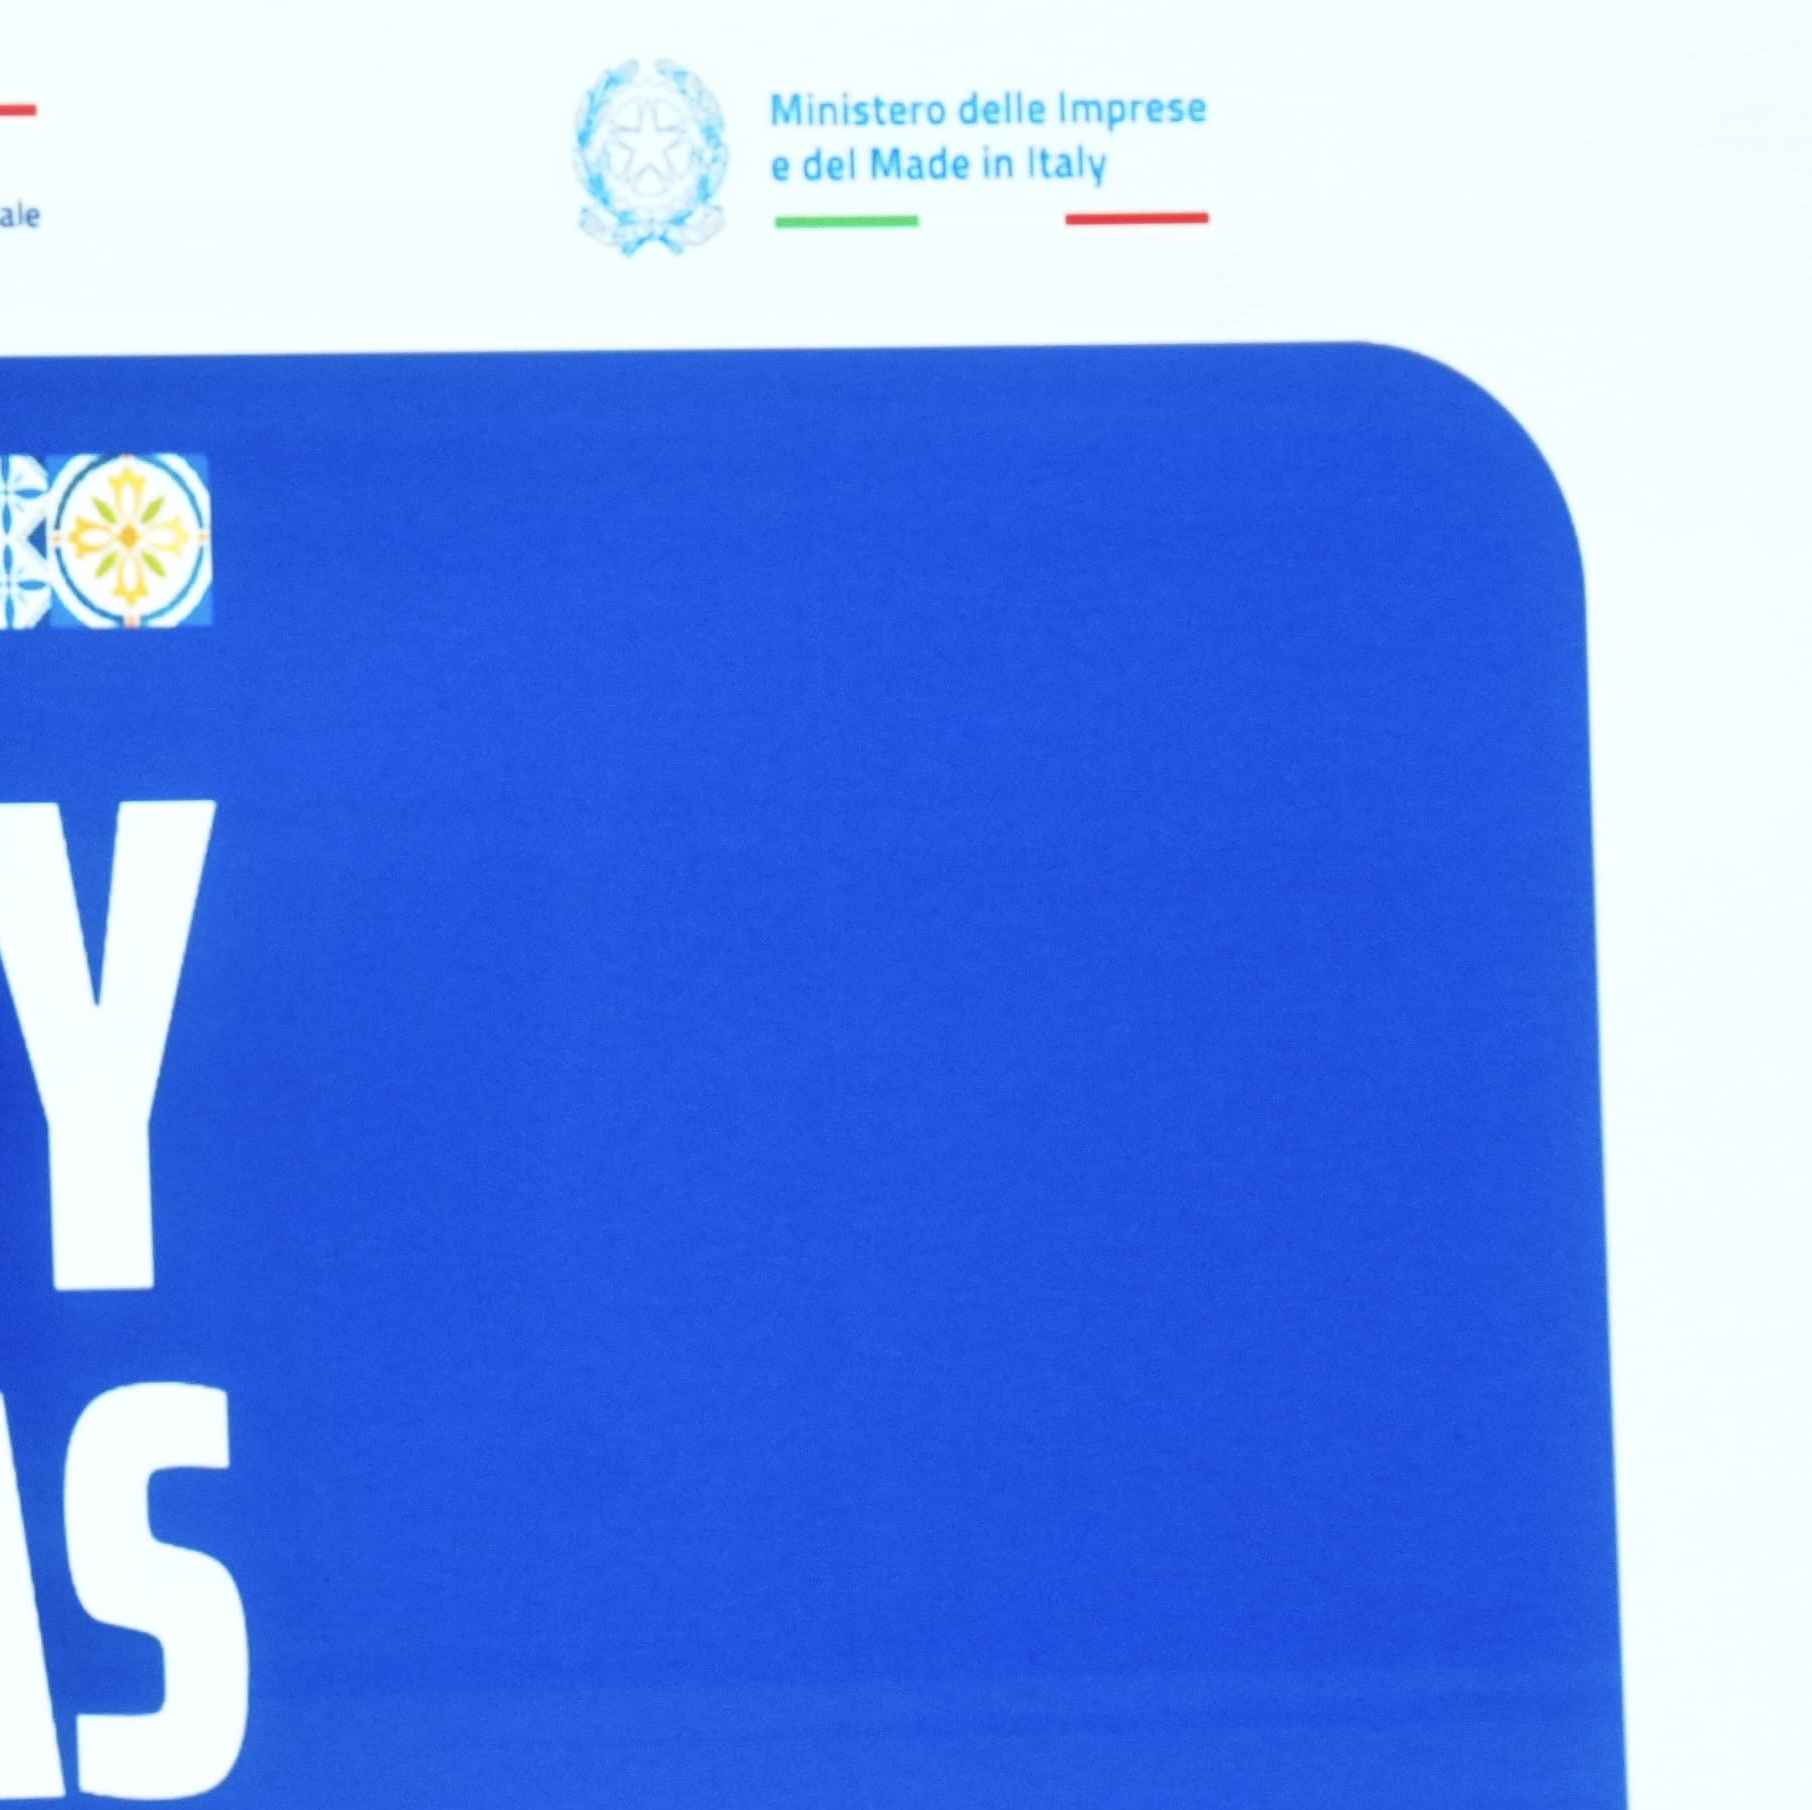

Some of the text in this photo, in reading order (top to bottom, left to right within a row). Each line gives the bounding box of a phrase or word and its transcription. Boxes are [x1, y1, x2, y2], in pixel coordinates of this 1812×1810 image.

[770, 90, 1208, 132] Ministero delle Imprese
[771, 145, 1109, 189] e del Made in Italy
